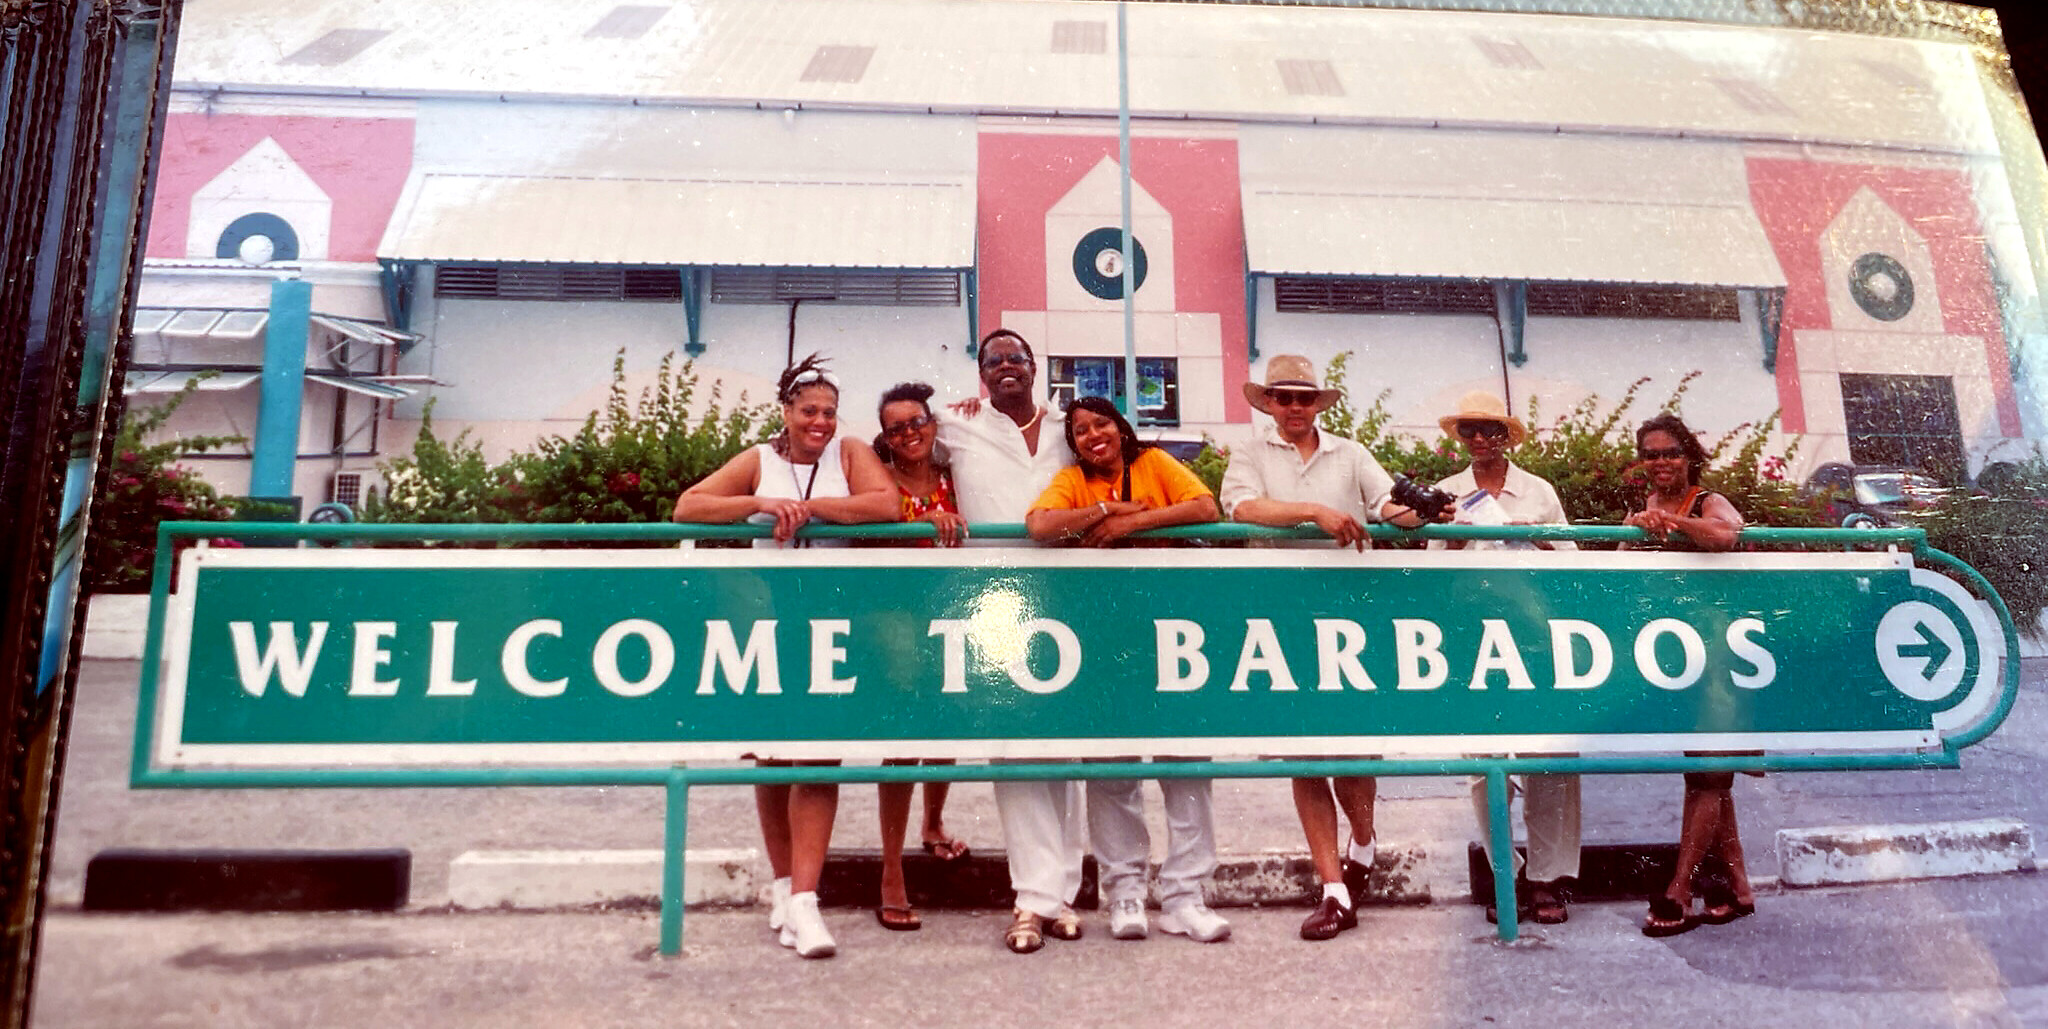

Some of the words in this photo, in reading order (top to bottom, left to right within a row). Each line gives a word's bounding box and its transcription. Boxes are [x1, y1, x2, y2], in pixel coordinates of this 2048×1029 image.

[229, 618, 857, 697] WELCOME
[928, 618, 1082, 694] TO
[1153, 617, 1777, 692] BARBADOS
